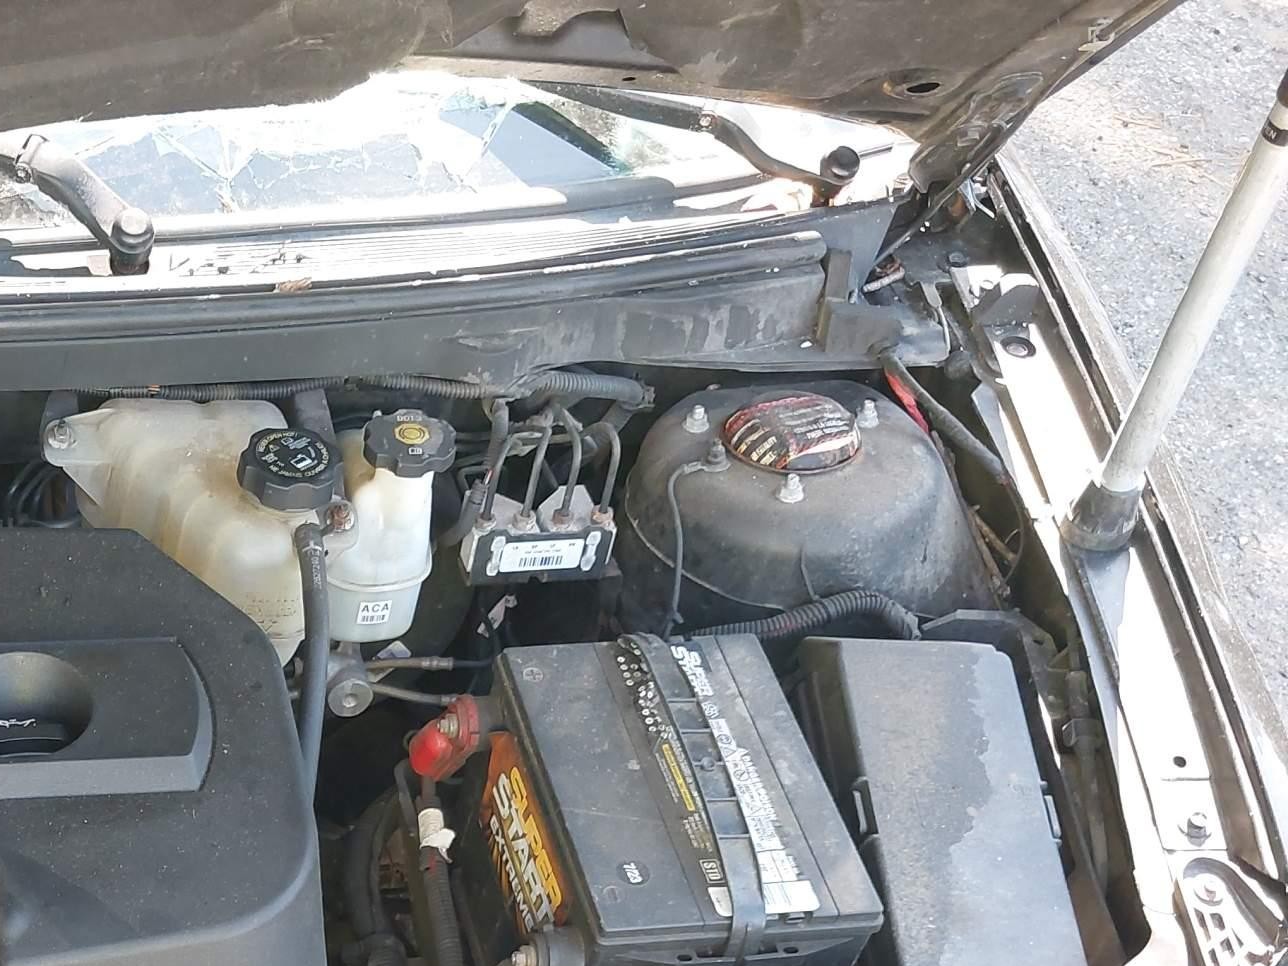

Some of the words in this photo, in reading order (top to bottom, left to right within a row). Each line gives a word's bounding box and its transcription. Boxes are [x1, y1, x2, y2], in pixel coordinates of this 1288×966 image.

[361, 603, 389, 612] ACA
[492, 773, 554, 923] START
[509, 767, 562, 912] SUPER
[622, 862, 643, 884] 7/23
